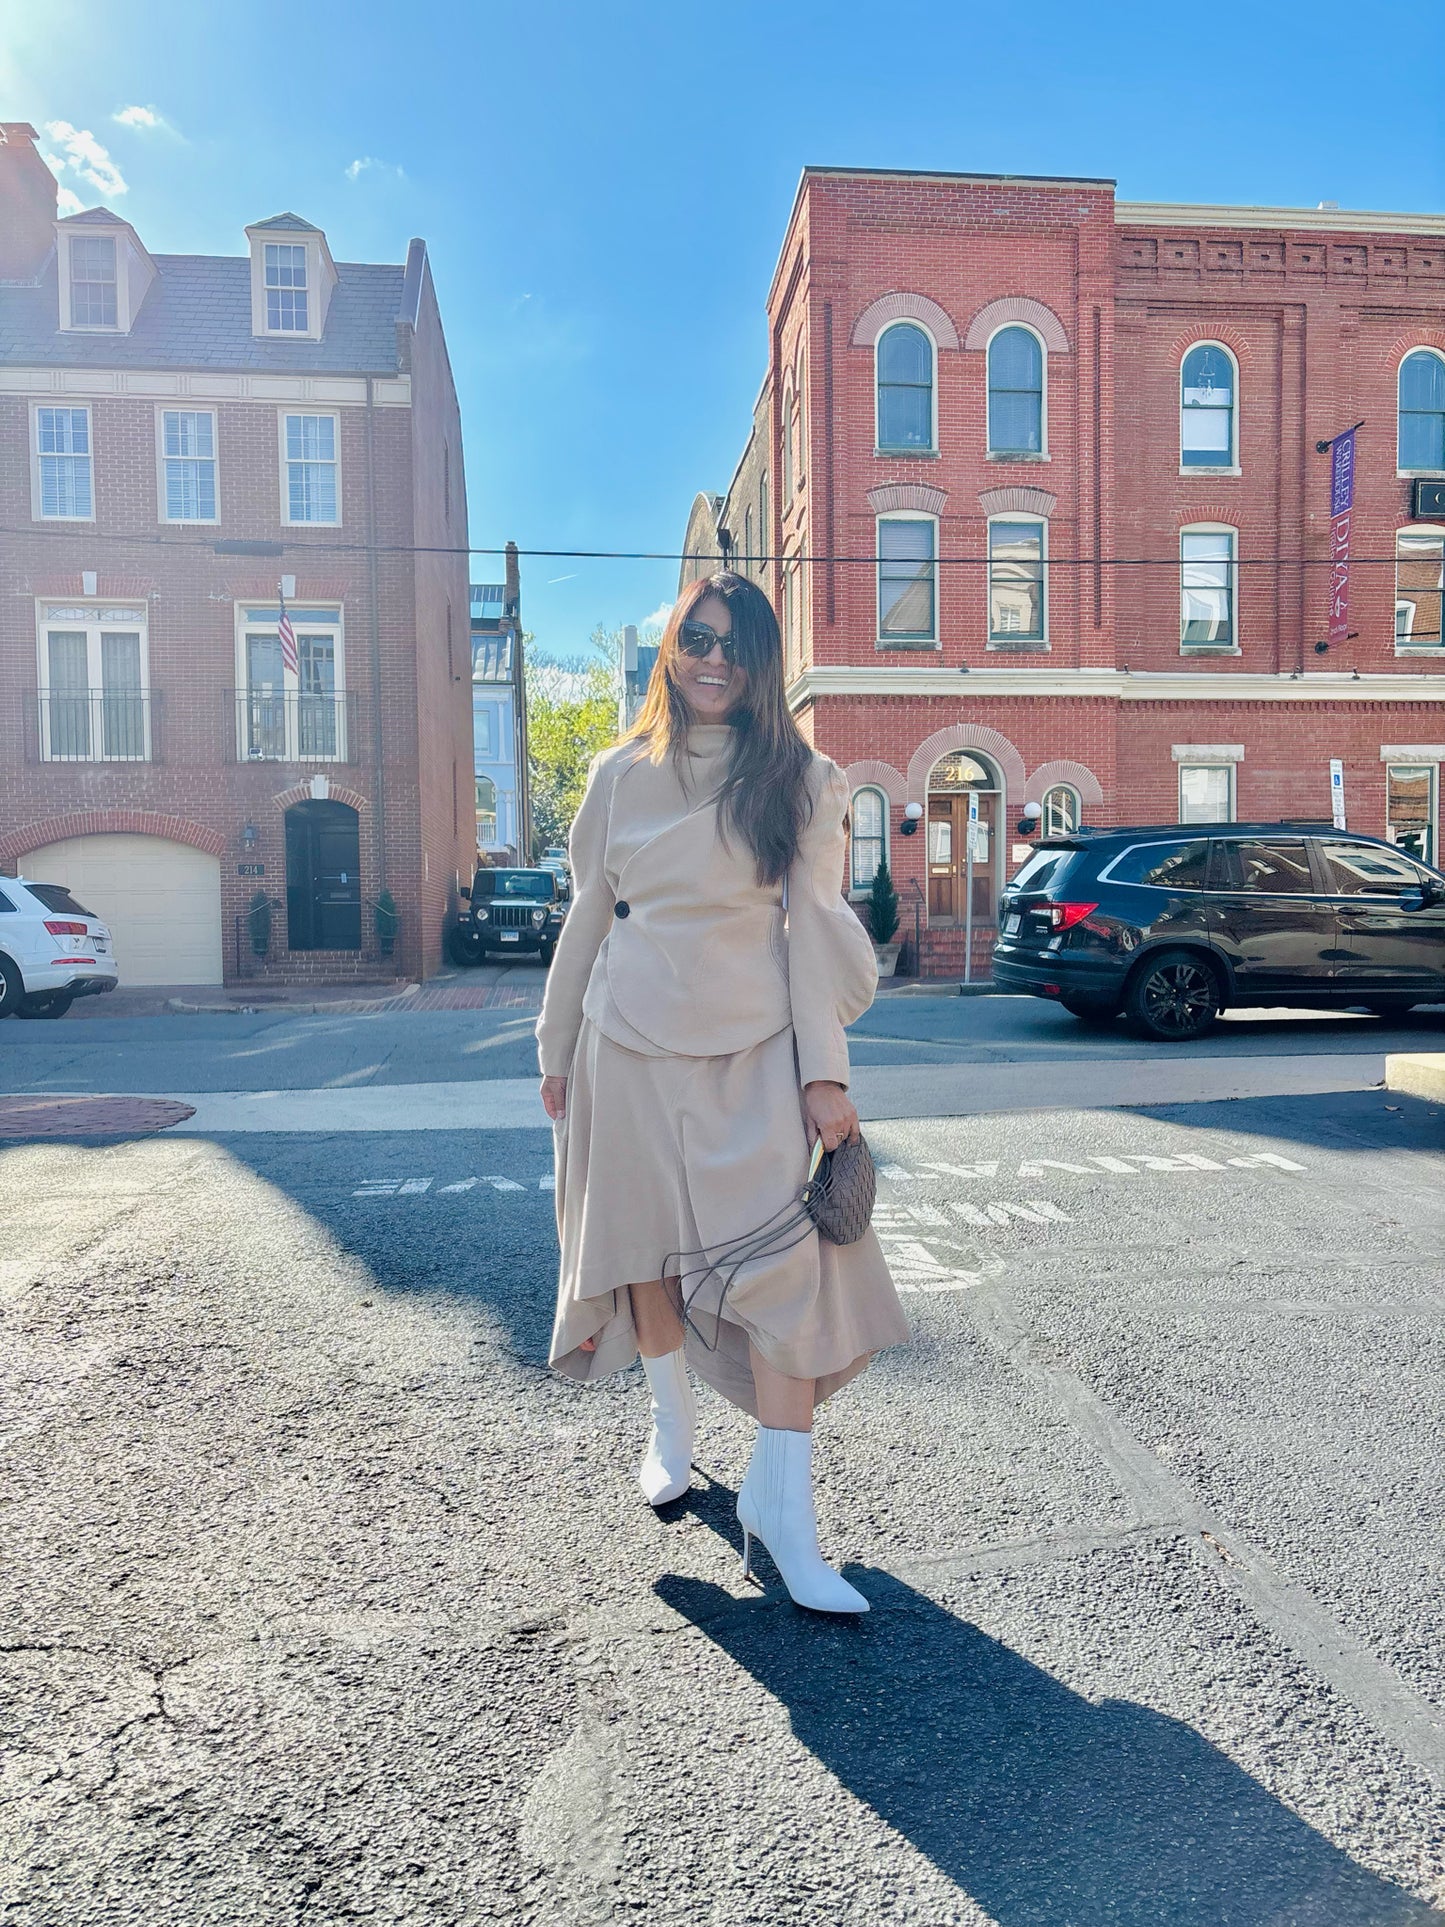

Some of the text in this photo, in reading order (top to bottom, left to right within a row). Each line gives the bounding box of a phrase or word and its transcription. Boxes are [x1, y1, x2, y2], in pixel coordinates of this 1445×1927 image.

[1334, 445, 1343, 514] WAREHOUSE
[1341, 440, 1352, 507] CRILLEY
[1336, 517, 1350, 592] DIYA
[945, 765, 975, 781] 216
[244, 865, 258, 875] 214
